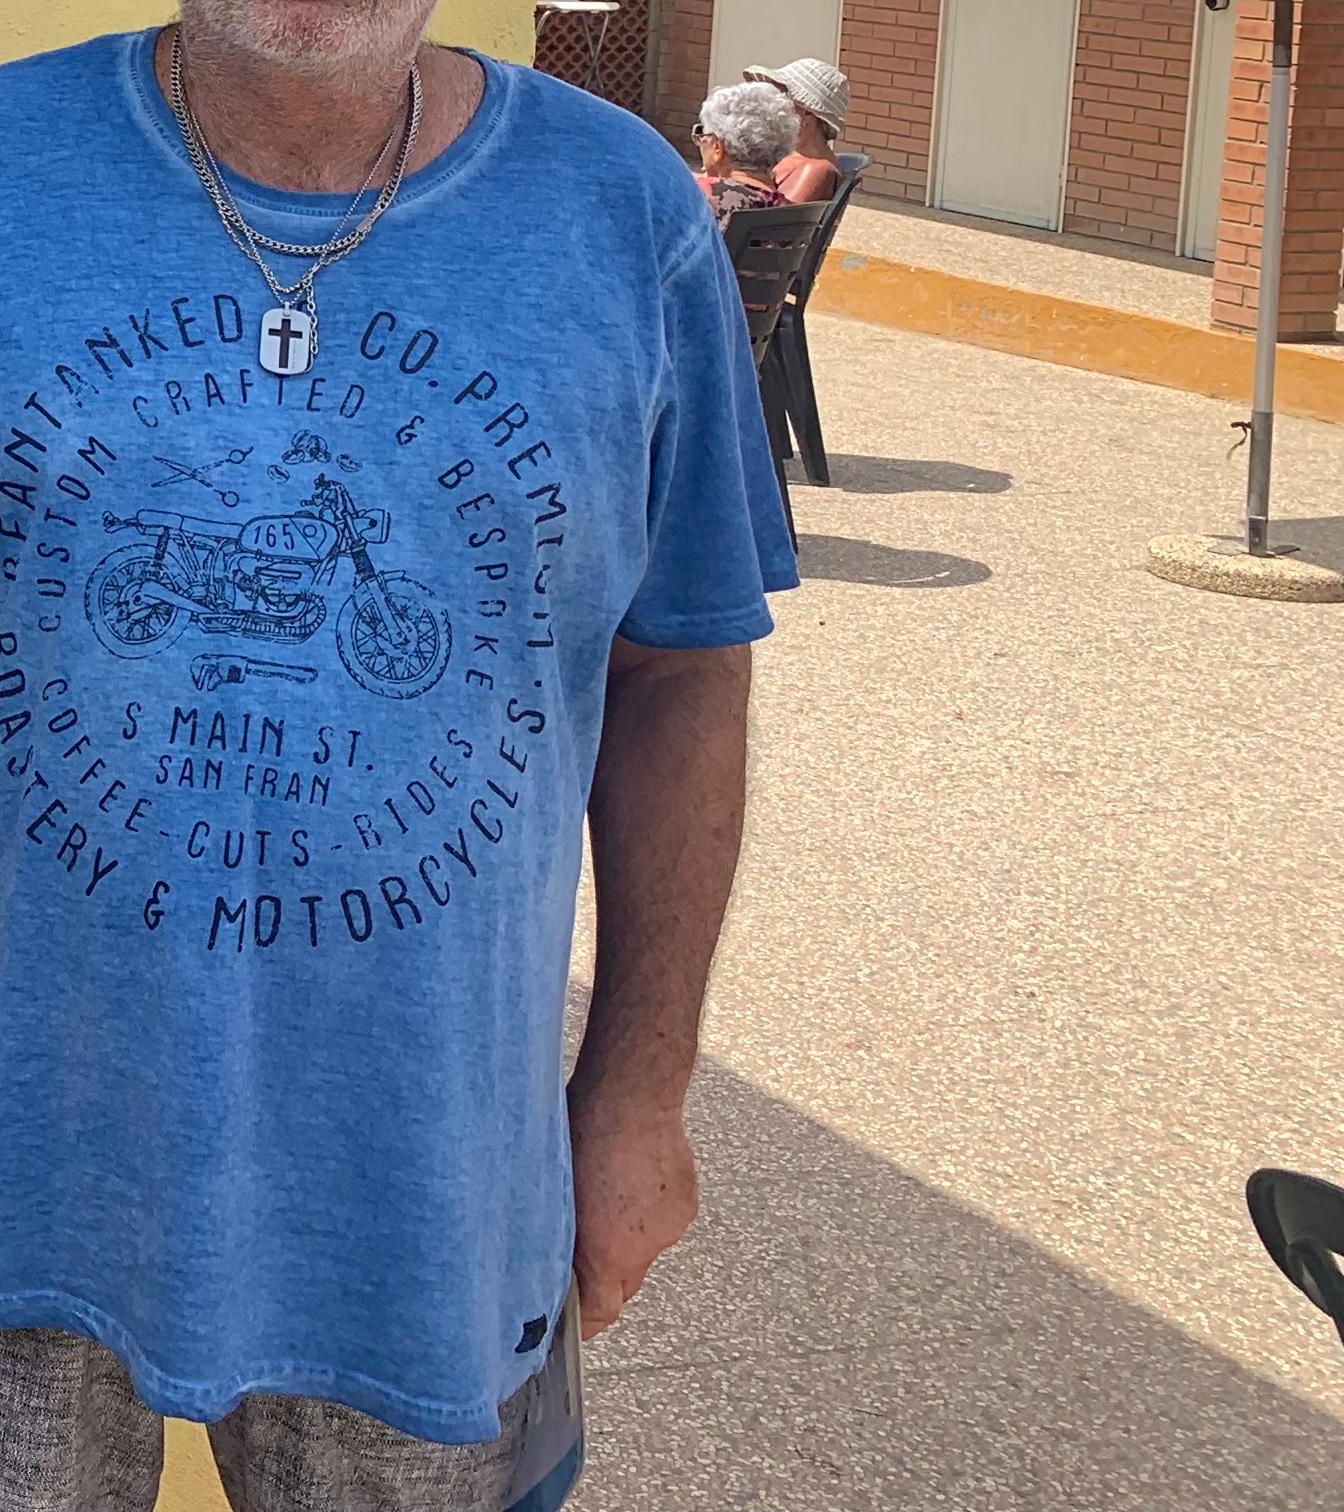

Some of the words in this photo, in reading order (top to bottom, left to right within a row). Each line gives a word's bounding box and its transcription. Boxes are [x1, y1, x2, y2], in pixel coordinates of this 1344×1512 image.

[36, 435, 117, 633] CUSTOM
[131, 365, 365, 428] CRAFTED
[394, 414, 426, 446] &
[436, 457, 510, 691] BESPOKE
[154, 754, 224, 791] SAN
[243, 763, 331, 807] FRAN
[168, 705, 285, 758] MAIN
[312, 725, 374, 772] ST.
[143, 880, 170, 931] &
[207, 697, 546, 954] MOTORCYCLES
